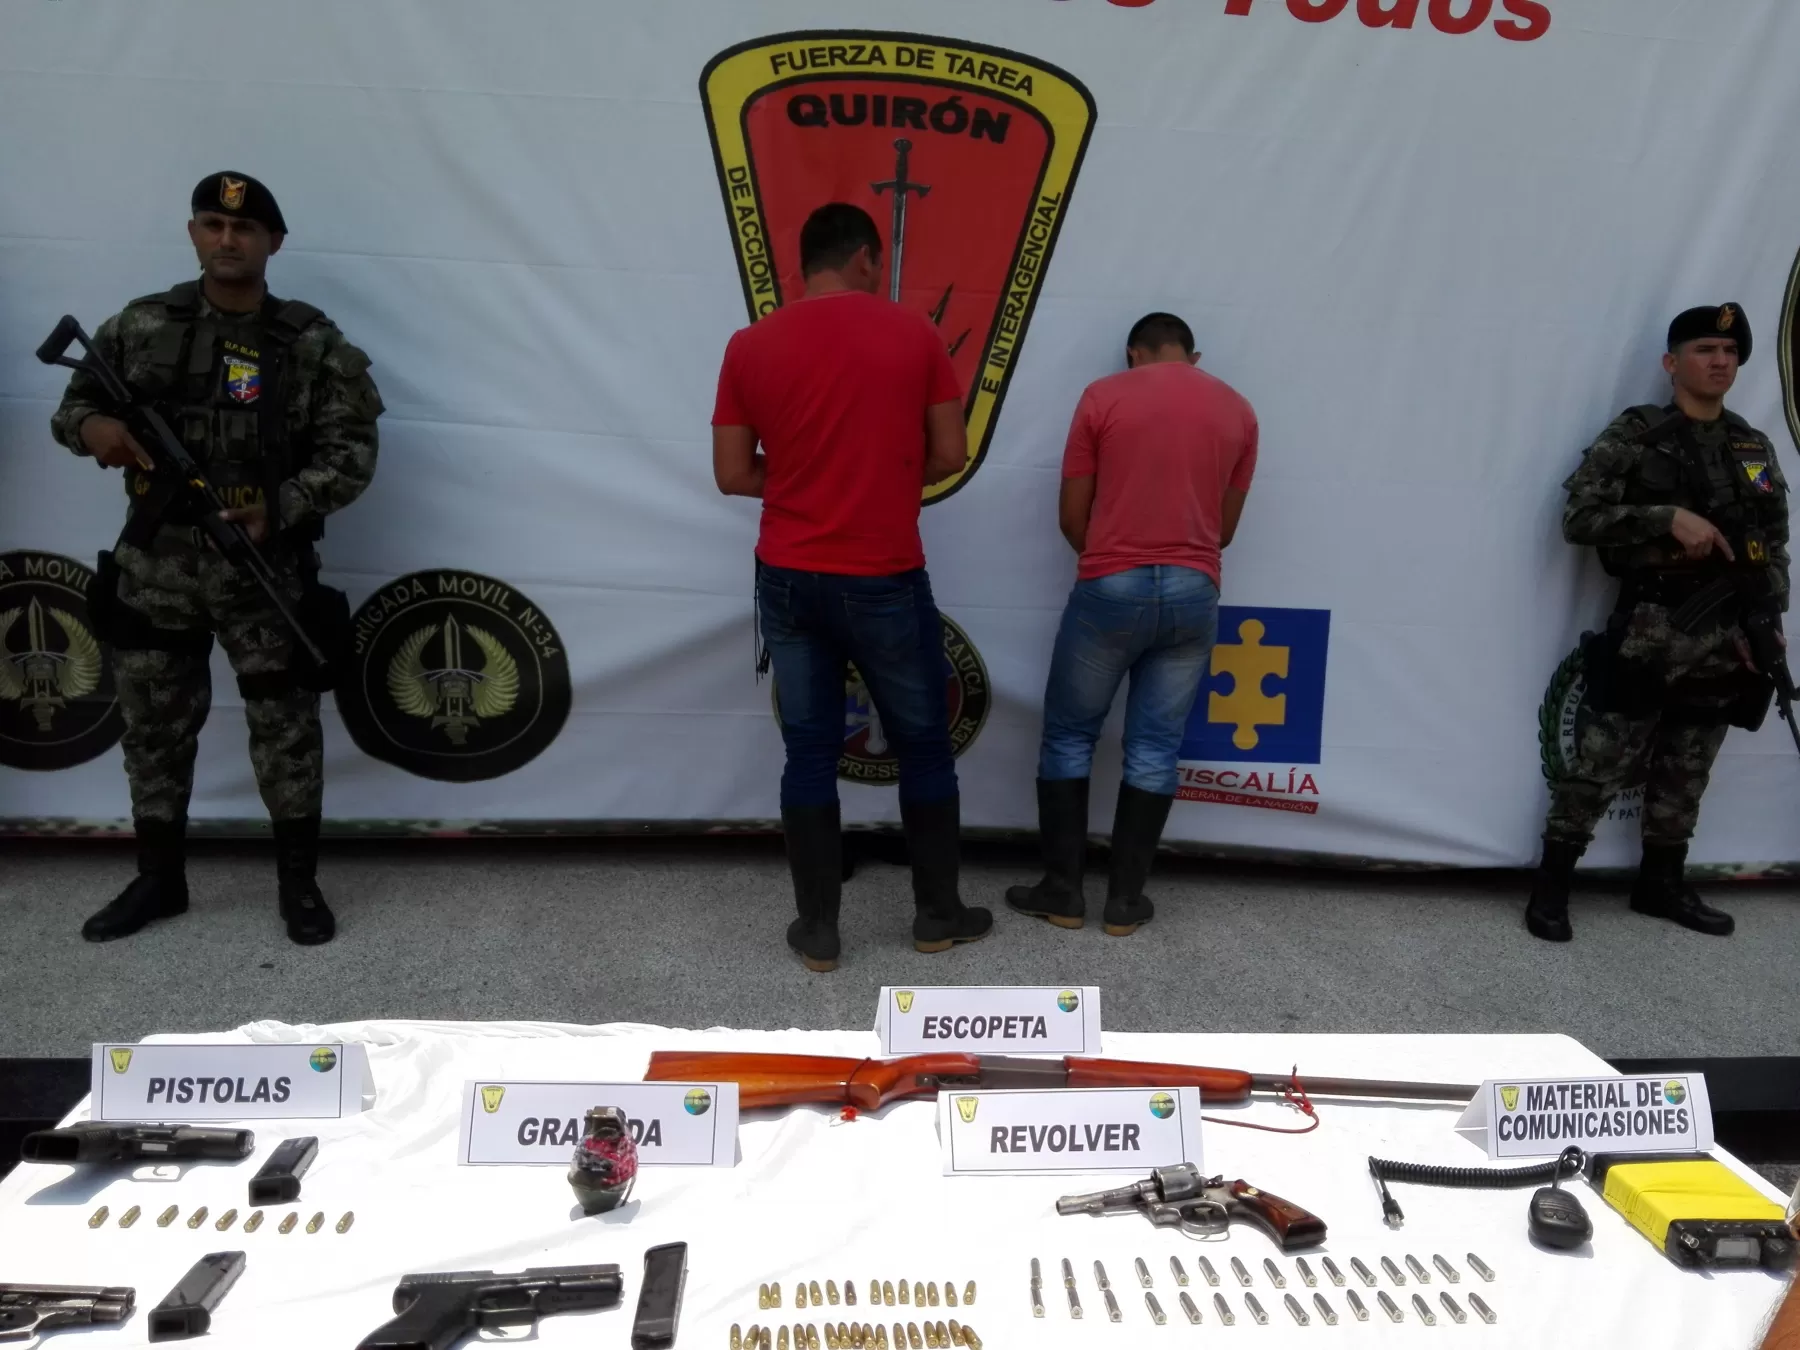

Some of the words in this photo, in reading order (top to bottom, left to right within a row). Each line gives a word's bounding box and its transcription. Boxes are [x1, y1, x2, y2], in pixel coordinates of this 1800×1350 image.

[770, 45, 887, 75] FUERZA
[895, 46, 936, 70] DE
[944, 52, 1034, 97] TAREA
[787, 94, 1012, 145] QUIRÓN
[727, 166, 752, 201] DE
[735, 205, 773, 295] ACCION
[989, 191, 1061, 369] INTERAGENCIAL
[980, 376, 1000, 394] E
[437, 574, 512, 612] MOVIL
[1175, 788, 1222, 801] ENERAL
[1225, 794, 1244, 803] DE
[1245, 796, 1262, 806] LA
[1264, 798, 1315, 813] NACIÓN
[922, 1015, 1048, 1039] ESCOPETA
[146, 1076, 292, 1104] PISTOLAS
[1526, 1082, 1631, 1112] MATERIAL
[1636, 1081, 1663, 1107] DE
[990, 1123, 1141, 1154] REVOLVER
[1499, 1108, 1689, 1142] COMUNICASIONES
